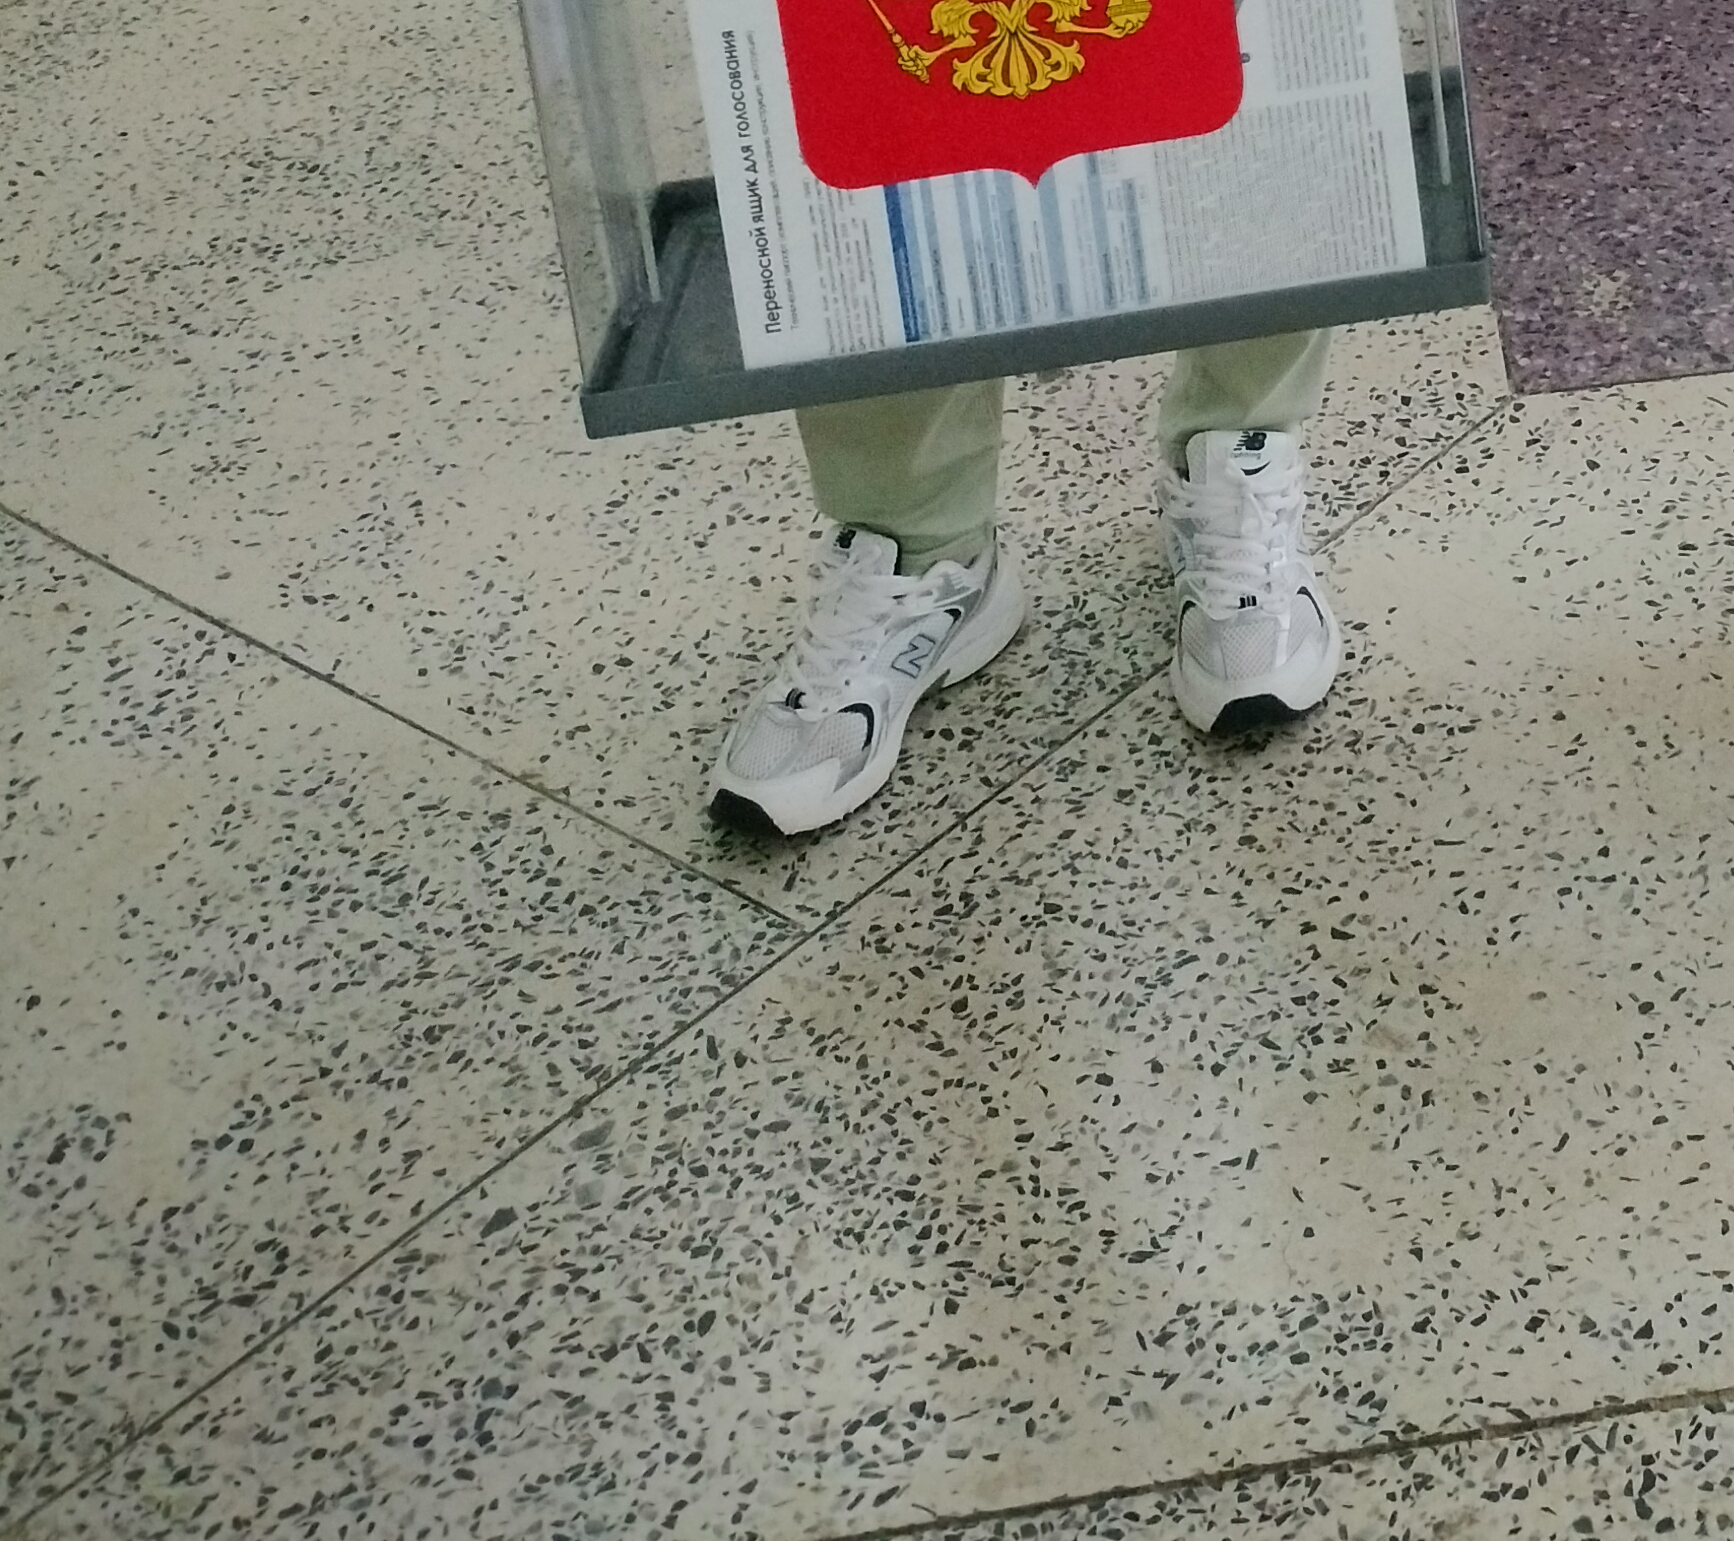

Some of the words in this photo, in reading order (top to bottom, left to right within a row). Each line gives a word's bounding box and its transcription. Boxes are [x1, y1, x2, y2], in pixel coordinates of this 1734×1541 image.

[721, 29, 751, 139] голосования
[740, 144, 759, 174] для
[746, 177, 765, 224] ящик
[749, 226, 783, 334] Переносной
